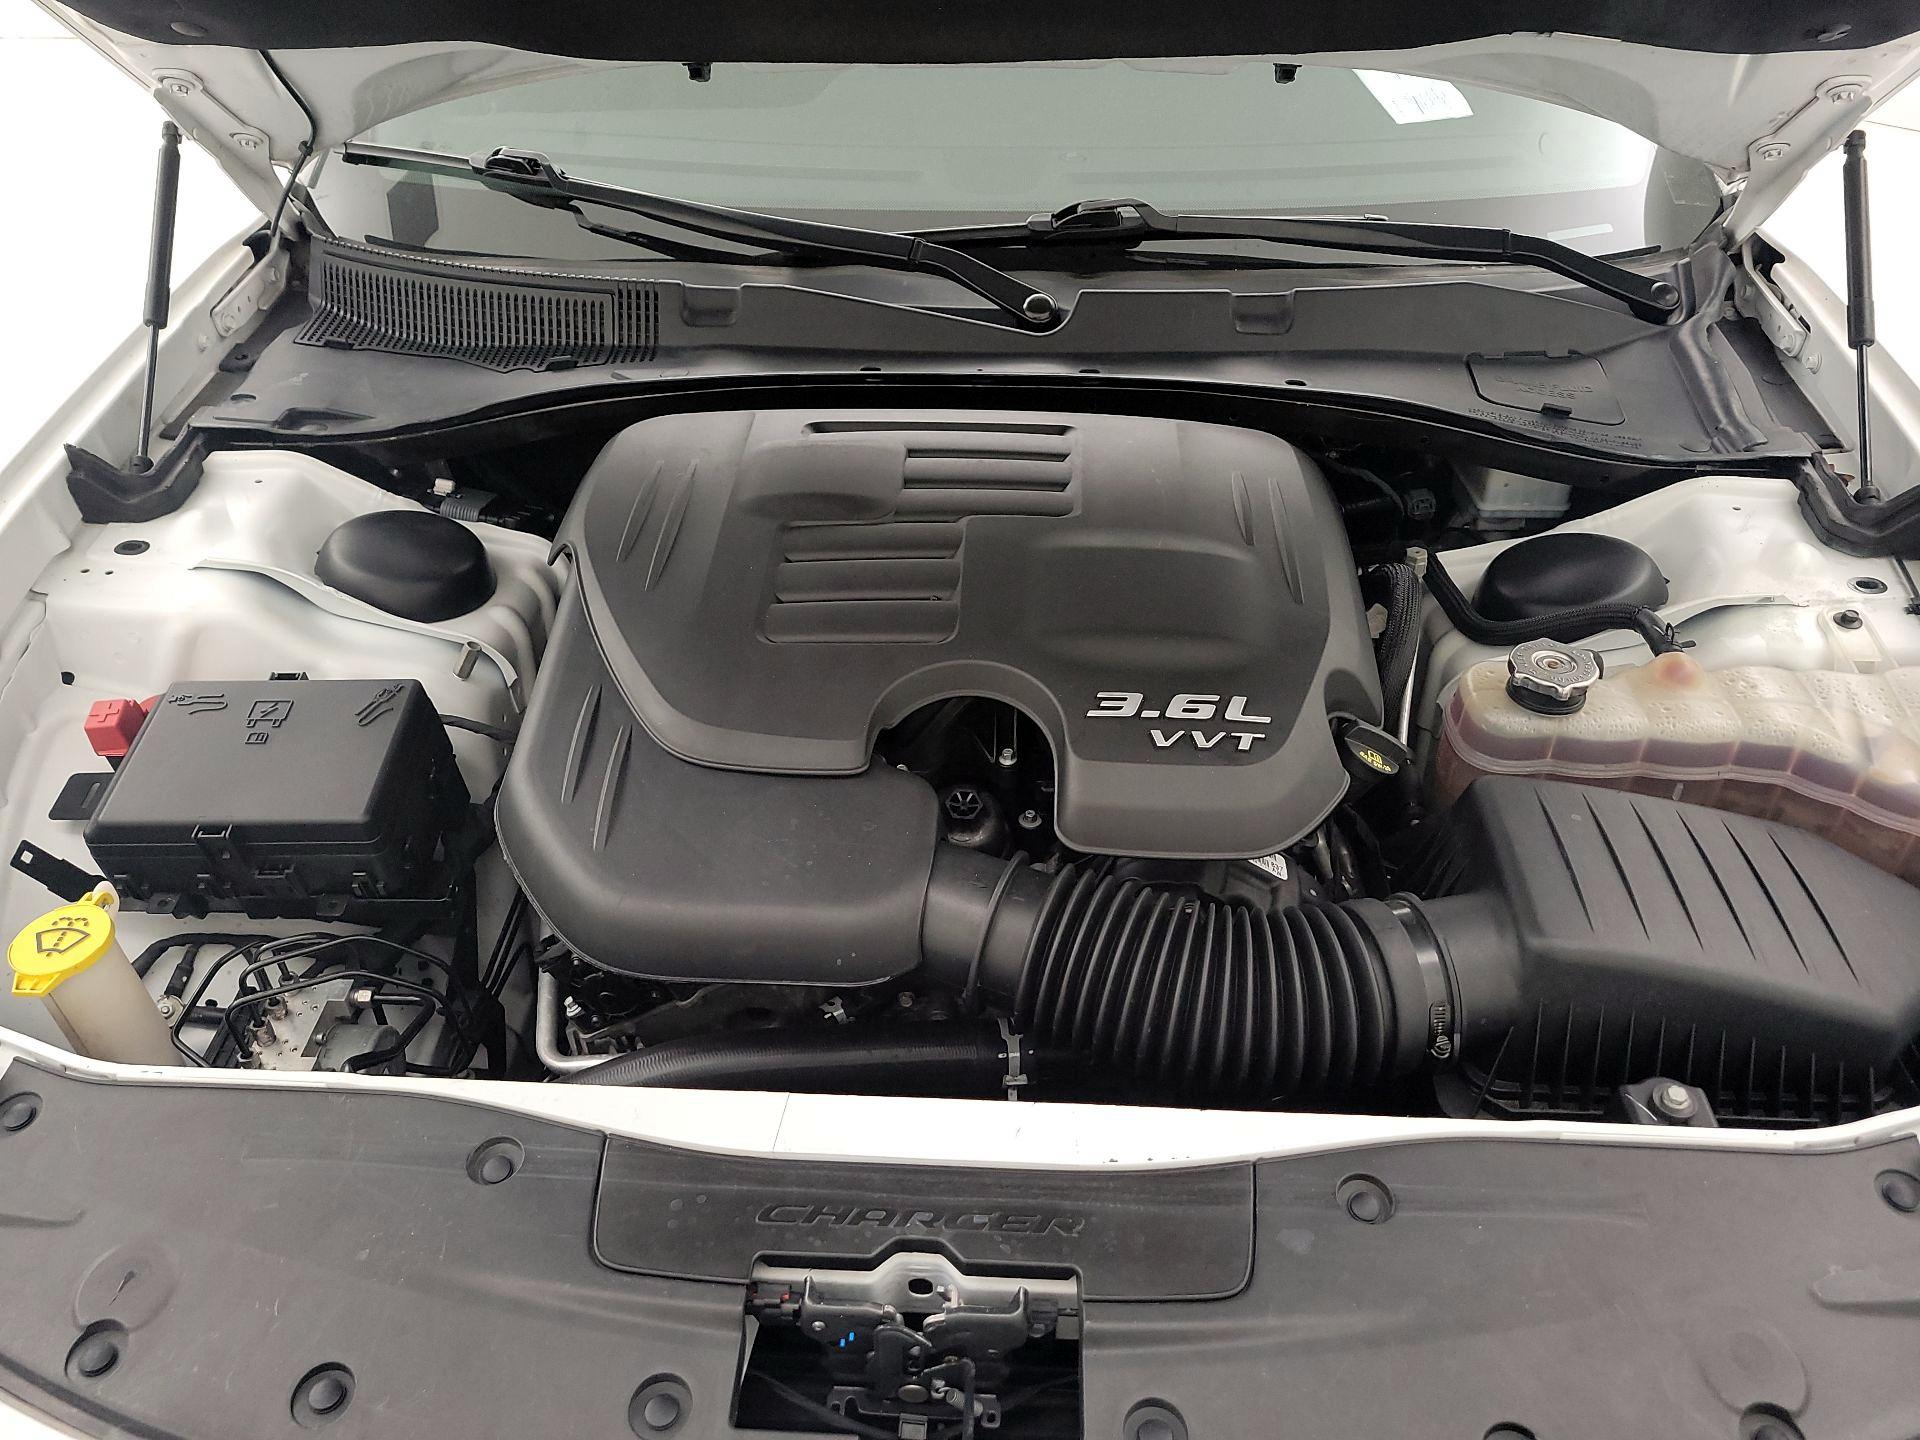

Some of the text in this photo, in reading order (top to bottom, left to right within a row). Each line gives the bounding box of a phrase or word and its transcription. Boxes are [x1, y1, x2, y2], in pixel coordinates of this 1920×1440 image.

[1086, 691, 1272, 724] 3.6L
[1150, 729, 1266, 751] VVT
[755, 1203, 1085, 1238] CHARGER
